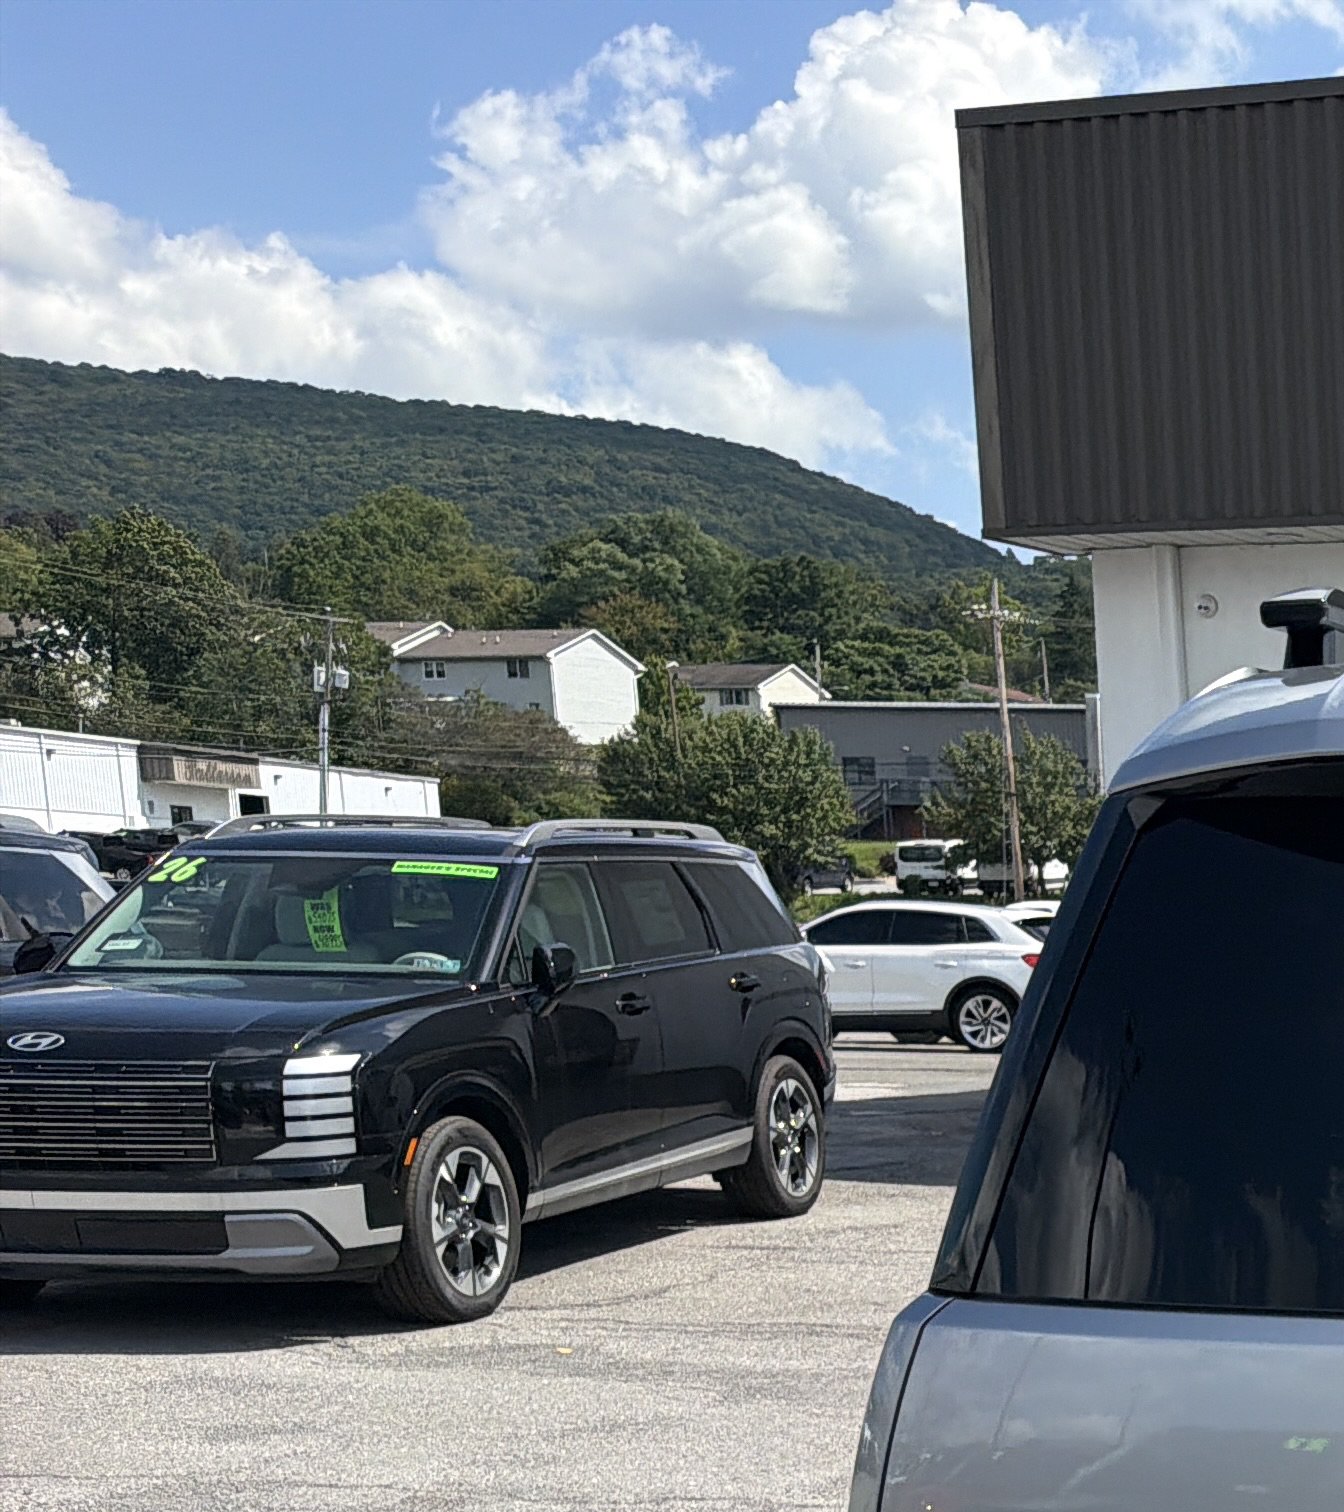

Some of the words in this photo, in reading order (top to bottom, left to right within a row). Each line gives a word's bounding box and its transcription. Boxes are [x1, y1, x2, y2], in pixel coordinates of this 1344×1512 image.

[147, 856, 208, 882] 26
[454, 866, 495, 876] SPECIAL
[313, 925, 335, 934] NOW
